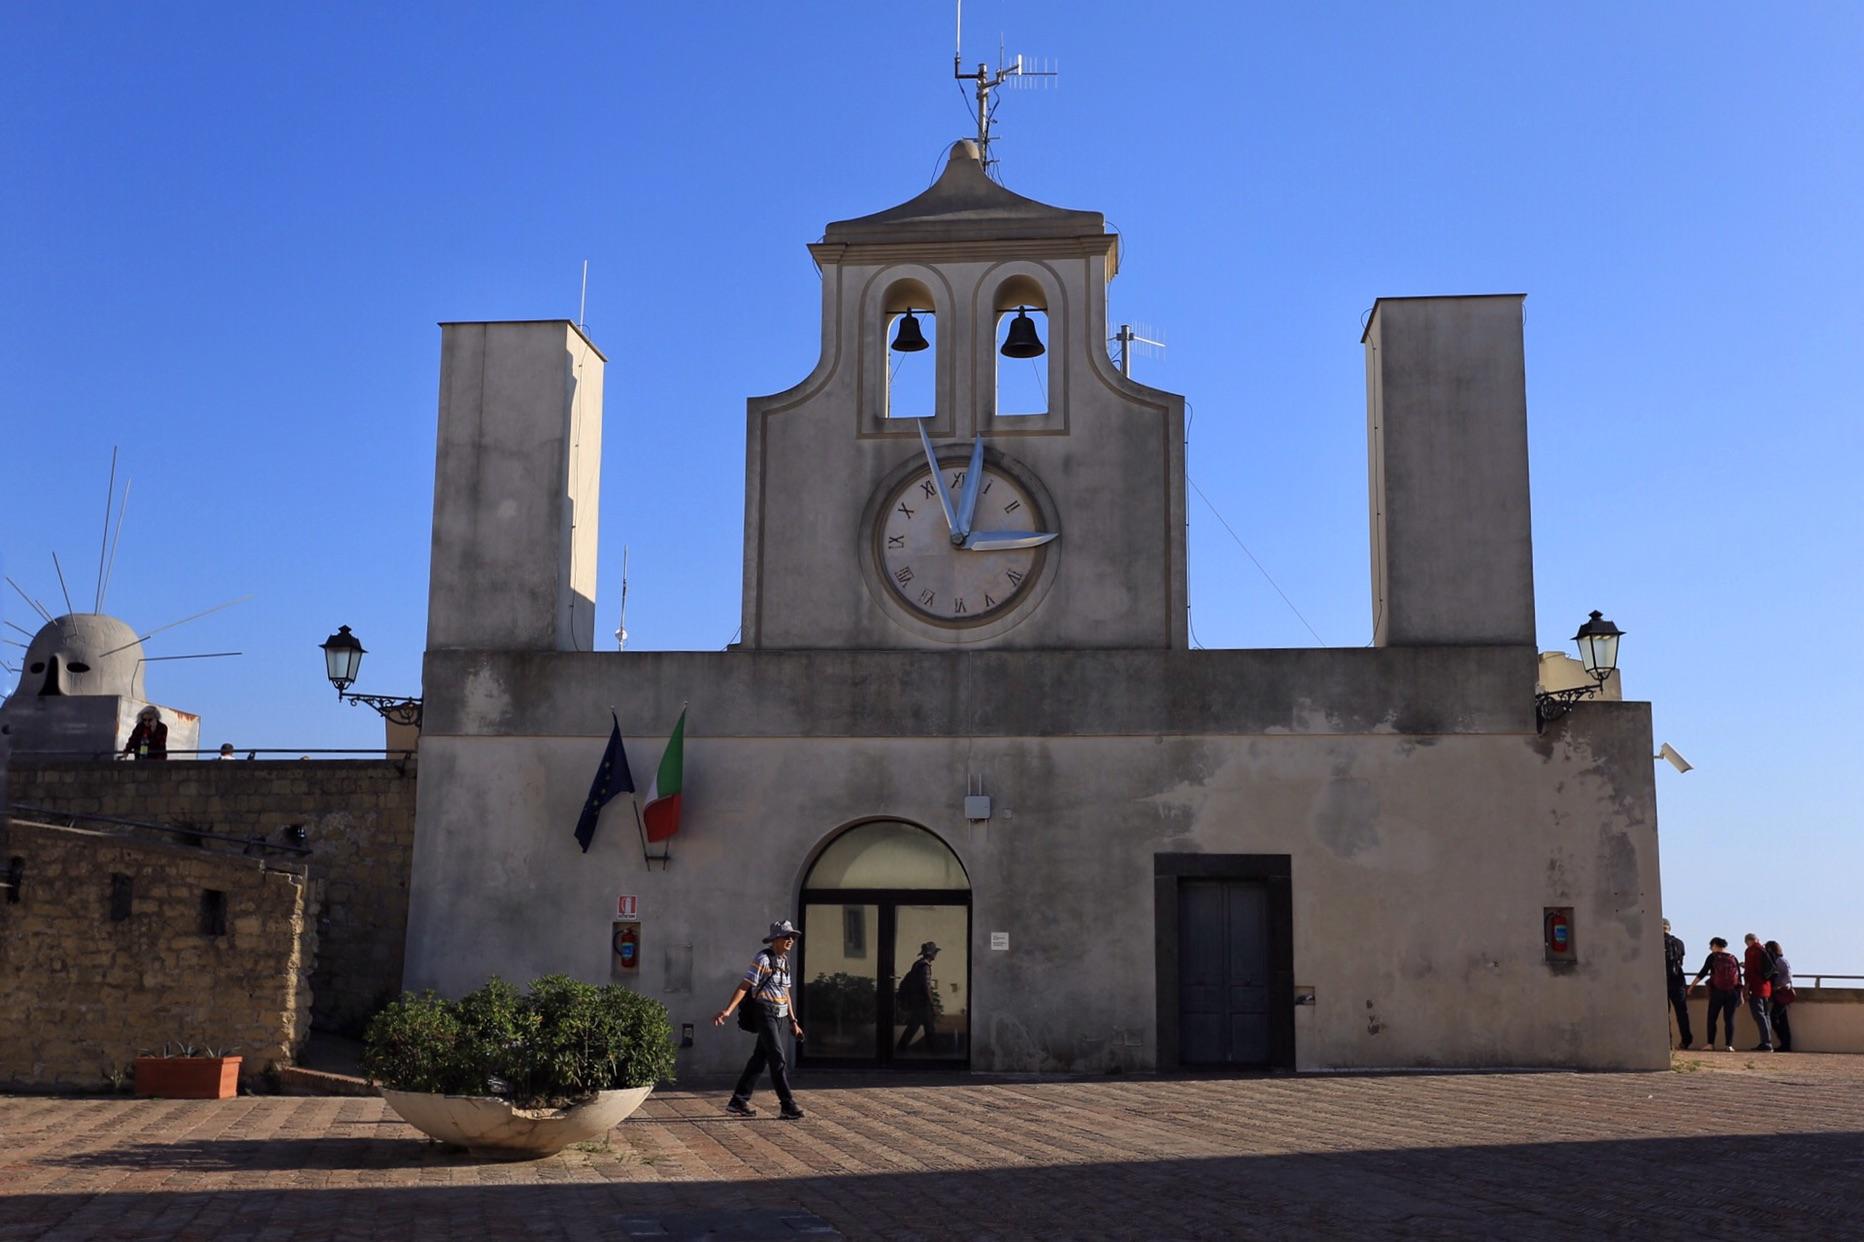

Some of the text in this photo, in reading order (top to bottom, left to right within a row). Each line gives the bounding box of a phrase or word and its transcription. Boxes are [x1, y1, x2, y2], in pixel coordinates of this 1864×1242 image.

[898, 501, 915, 520] X
[1004, 500, 1020, 514] II
[888, 534, 905, 550] IX
[894, 566, 915, 588] VIII
[985, 593, 996, 607] V
